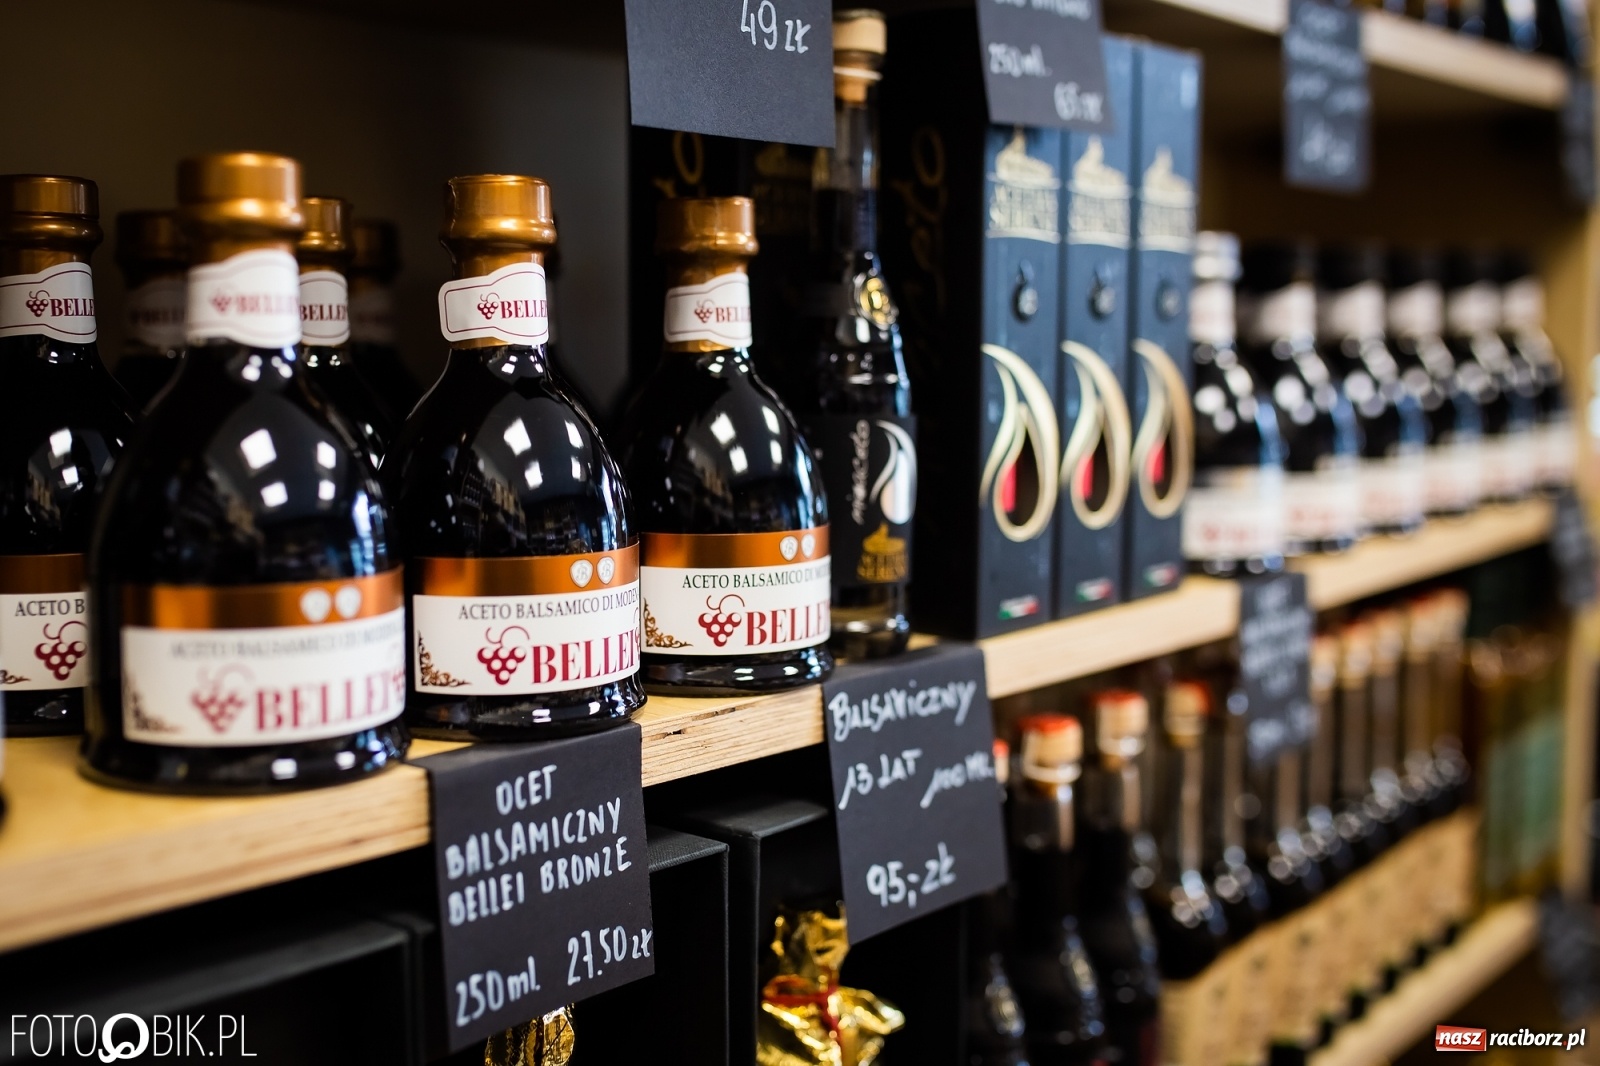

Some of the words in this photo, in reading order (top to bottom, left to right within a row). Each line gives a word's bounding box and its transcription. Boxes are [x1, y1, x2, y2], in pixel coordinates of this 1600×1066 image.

[741, 0, 777, 50] 49
[681, 574, 729, 589] ACETO
[733, 570, 802, 588] BALSAMICO
[15, 599, 70, 616] ACETO
[458, 603, 512, 620] ACETO
[516, 594, 599, 619] BALSAMICO
[603, 595, 613, 611] DI
[496, 764, 557, 815] OCET
[838, 762, 874, 811] 13
[877, 748, 923, 790] LAT
[445, 797, 621, 880] BALSAMICZNY
[448, 871, 525, 926] BELLEI
[540, 836, 632, 894] BRONZE
